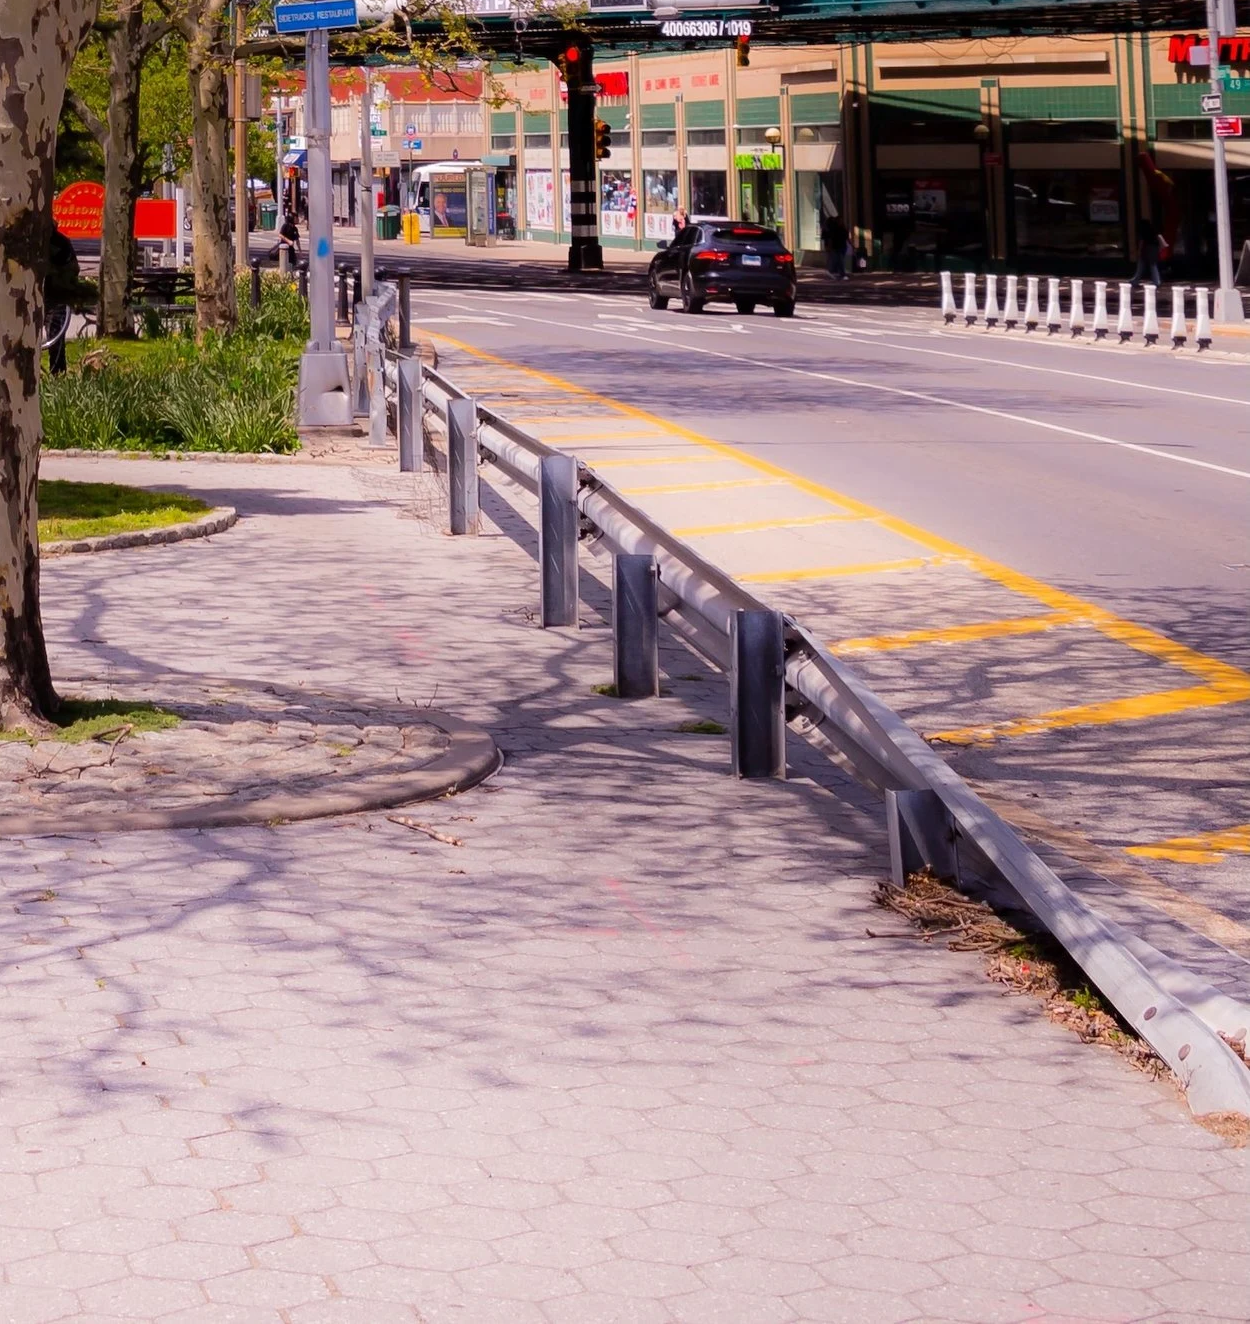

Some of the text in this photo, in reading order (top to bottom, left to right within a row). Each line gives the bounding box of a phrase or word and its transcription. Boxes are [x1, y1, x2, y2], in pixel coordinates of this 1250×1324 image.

[278, 8, 354, 23] SIDETRACKS RESTAURANT
[1230, 79, 1241, 90] 49
